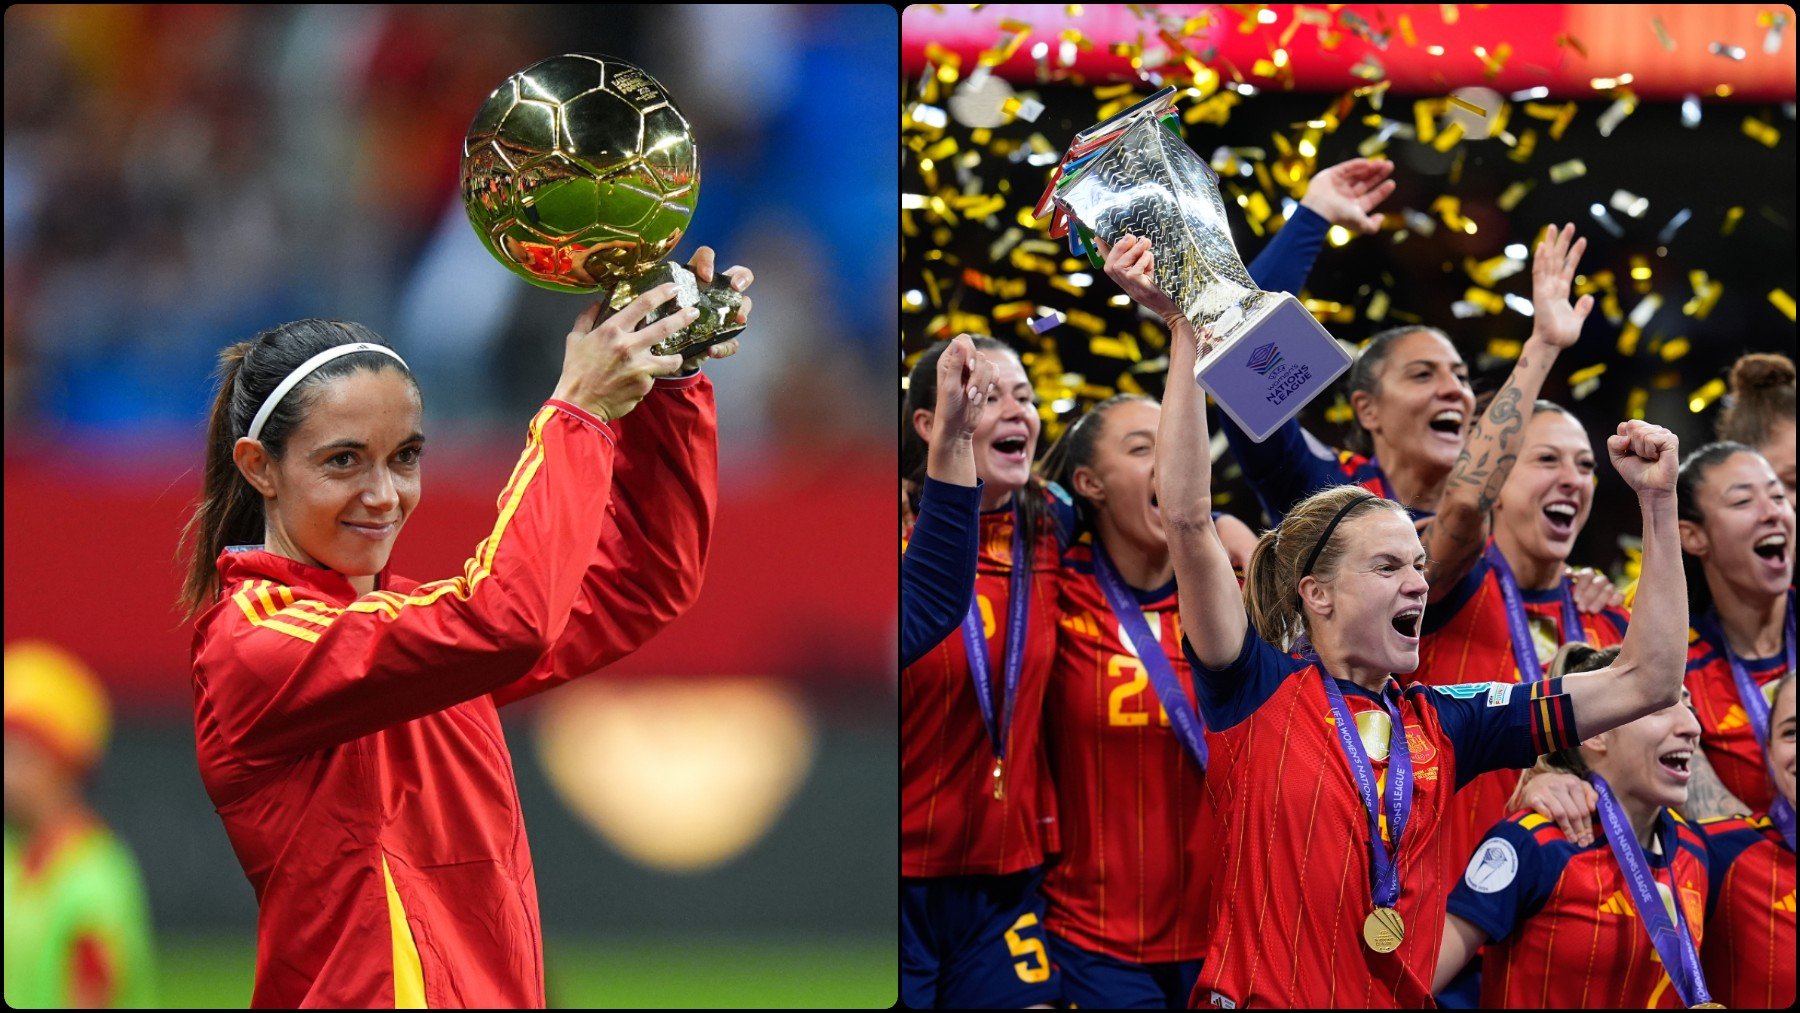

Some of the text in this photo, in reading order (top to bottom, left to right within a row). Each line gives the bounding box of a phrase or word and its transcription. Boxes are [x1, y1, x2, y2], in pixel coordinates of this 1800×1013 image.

[1266, 364, 1309, 402] NATIONS
[1273, 373, 1312, 406] LEAGUE
[1332, 707, 1372, 808] UEFA WOMEN'S NATIONS
[1393, 767, 1406, 800] LEAGUE
[1602, 792, 1624, 836] WOMEN'S
[1617, 834, 1639, 872] NATIONS
[1633, 869, 1653, 903] LEAGUE
[1004, 912, 1050, 984] 5
